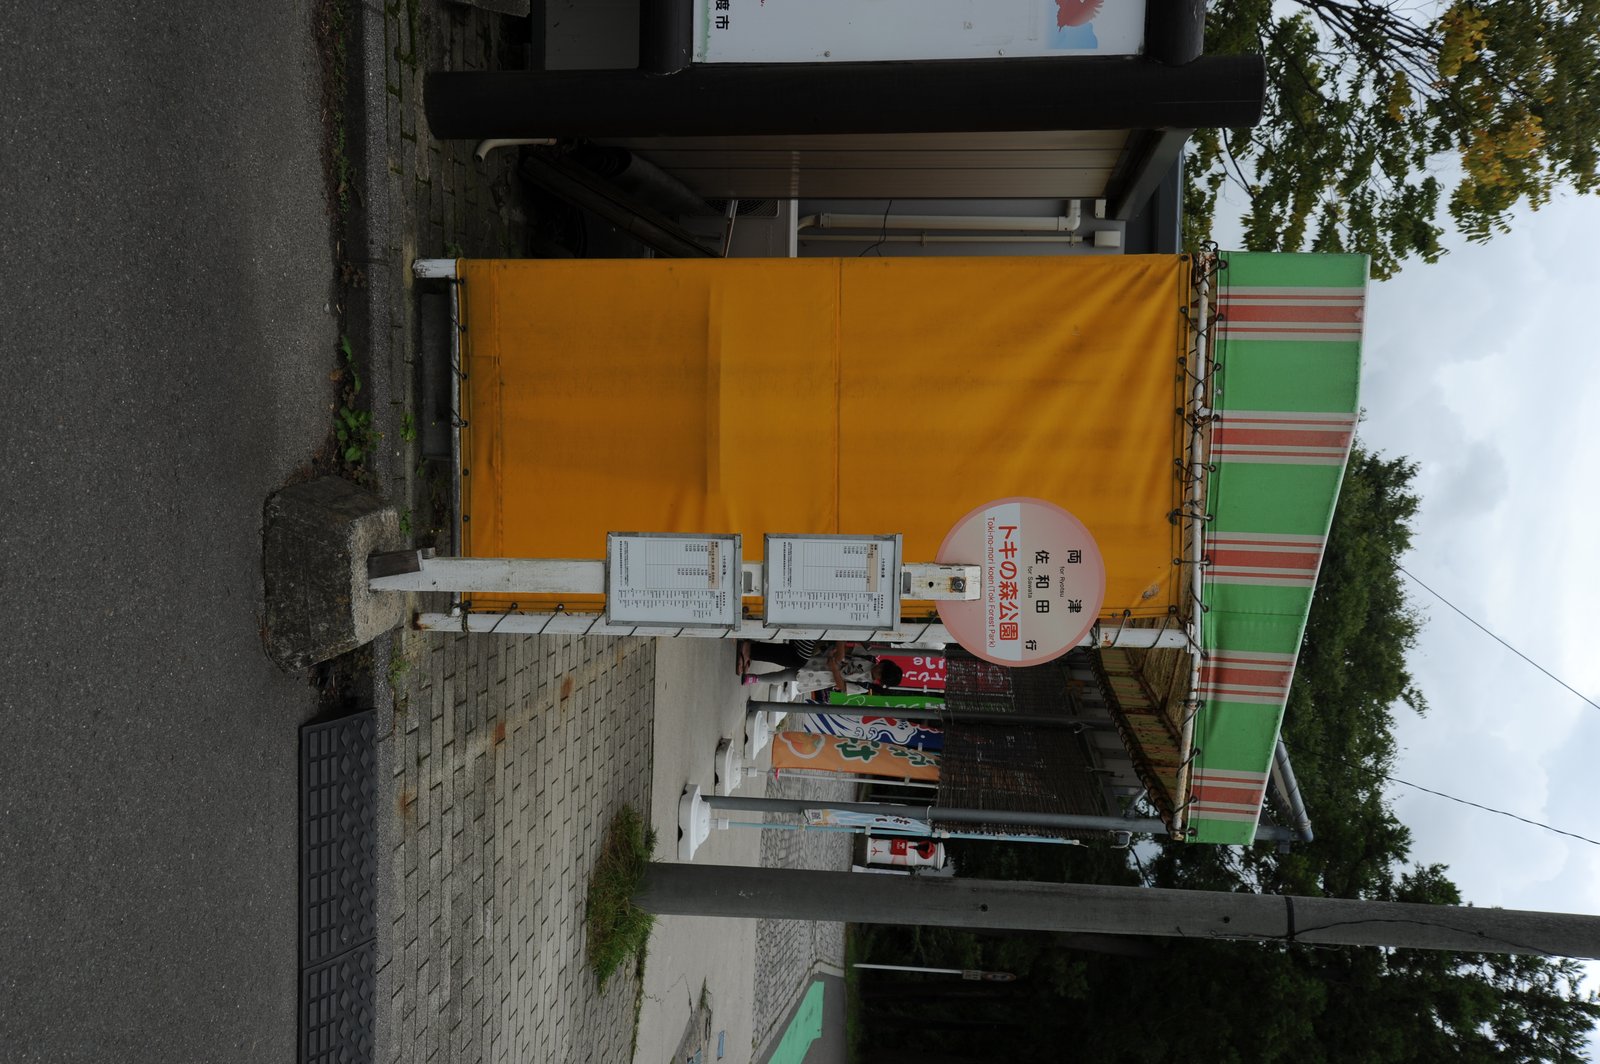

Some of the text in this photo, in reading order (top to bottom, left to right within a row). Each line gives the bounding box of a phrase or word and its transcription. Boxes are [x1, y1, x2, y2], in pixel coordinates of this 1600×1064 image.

[998, 525, 1019, 641] トキの森公園
[1035, 550, 1050, 614] 佐和田
[988, 605, 996, 628] Forest
[988, 629, 996, 648] Park)
[1025, 640, 1037, 651] 行
